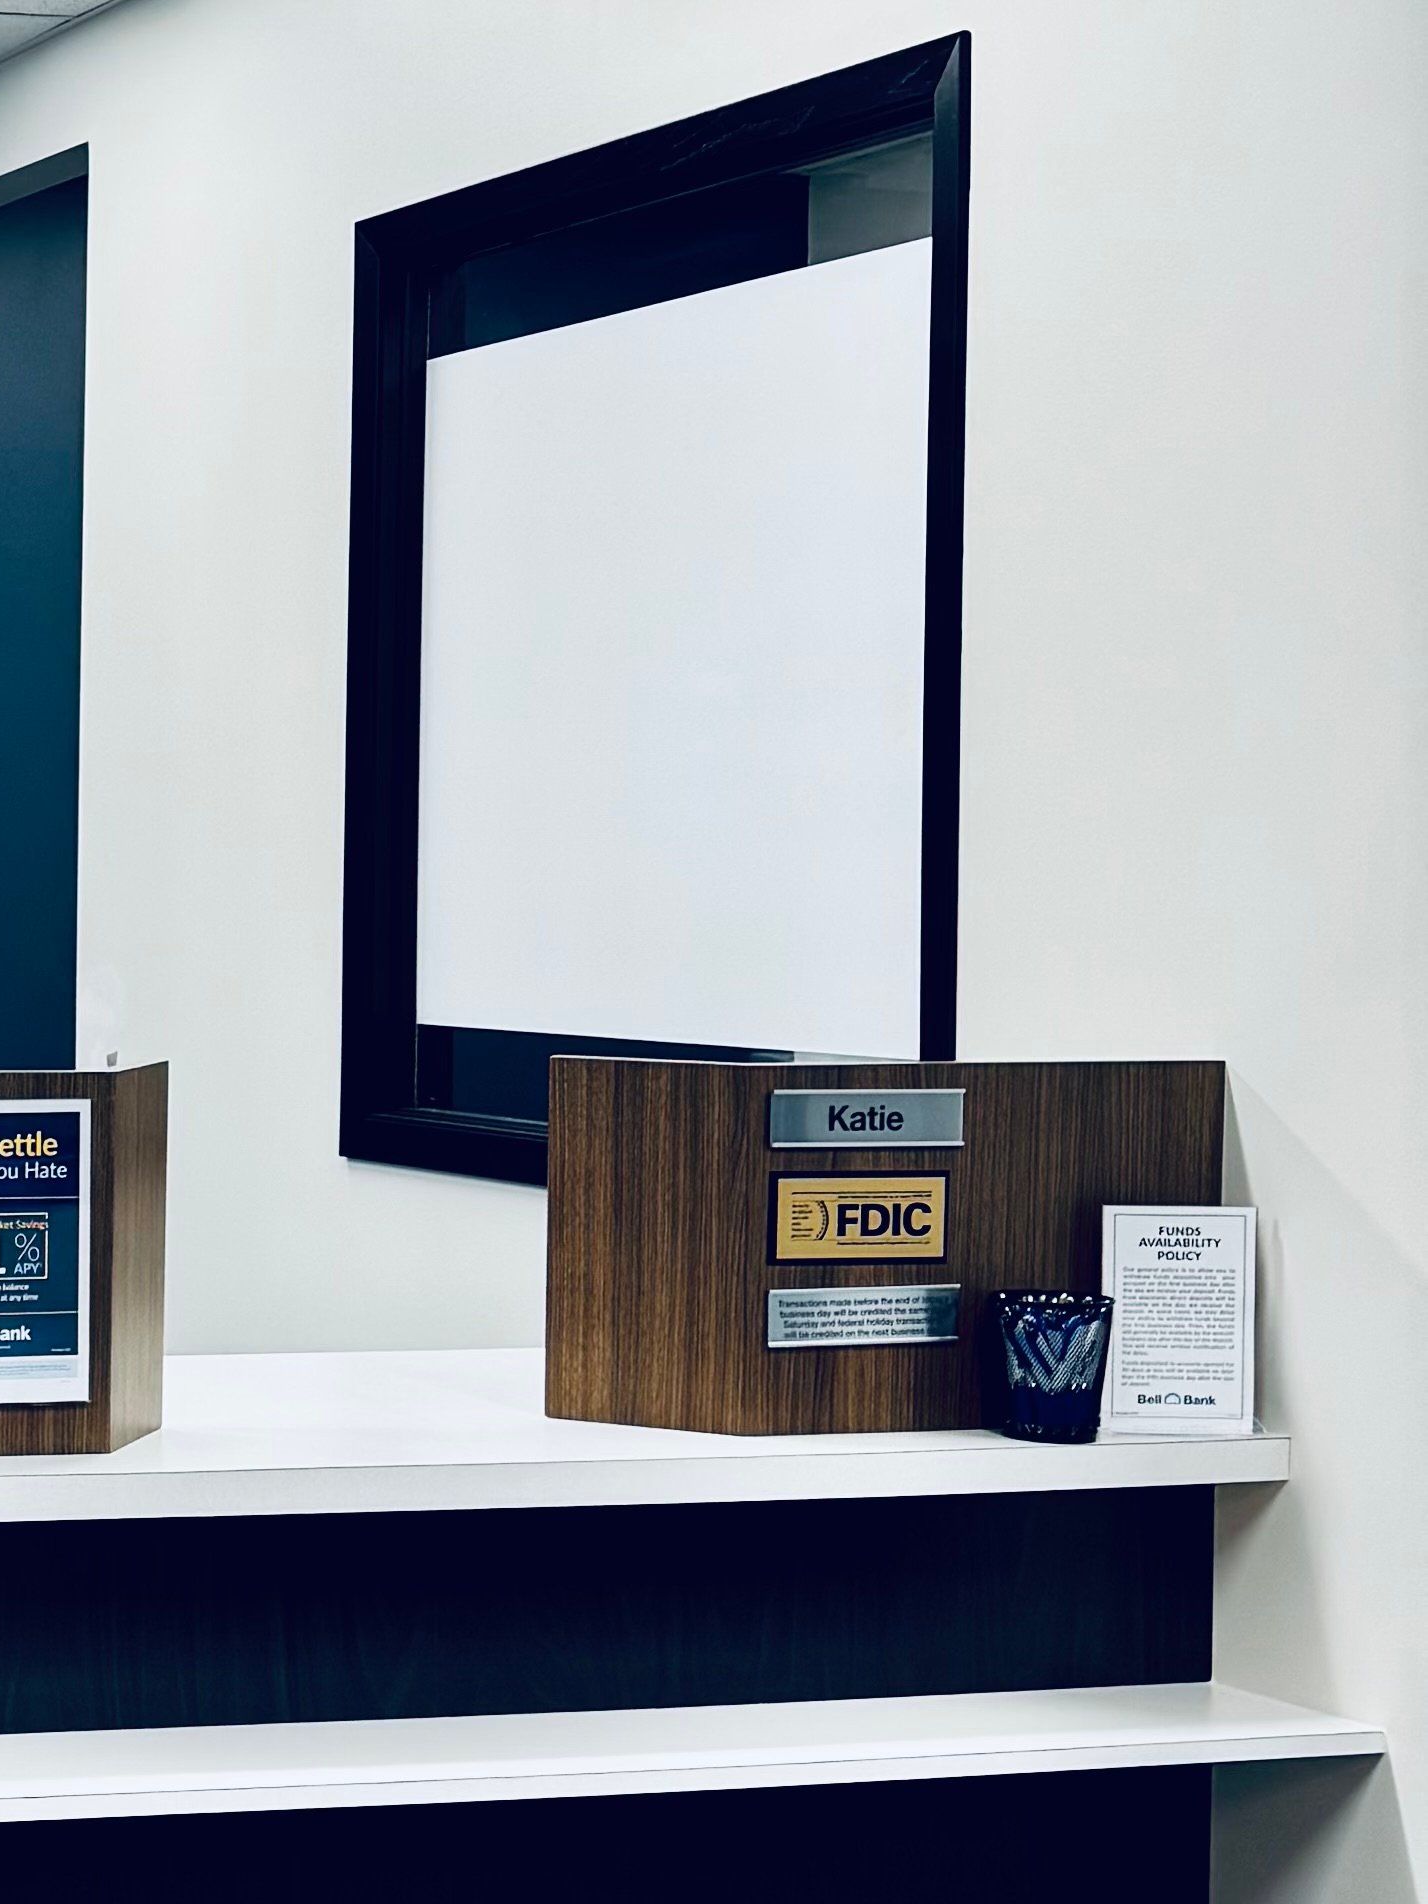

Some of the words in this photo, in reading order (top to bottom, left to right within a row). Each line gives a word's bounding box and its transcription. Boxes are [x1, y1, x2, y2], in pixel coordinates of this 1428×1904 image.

[828, 1104, 904, 1132] Katie
[24, 1161, 68, 1179] Hate
[15, 1219, 49, 1230] Savings
[837, 1202, 932, 1237] FDIC
[1159, 1226, 1201, 1236] FUNDS
[1139, 1237, 1221, 1248] AVAILABILITY
[1157, 1251, 1202, 1261] POLICY
[779, 1299, 827, 1308] Transactions
[829, 1299, 851, 1307] made
[854, 1298, 879, 1306] before
[881, 1297, 893, 1305] the
[817, 1310, 831, 1319] day
[1137, 1394, 1162, 1404] Bell
[1184, 1395, 1216, 1405] Bank
